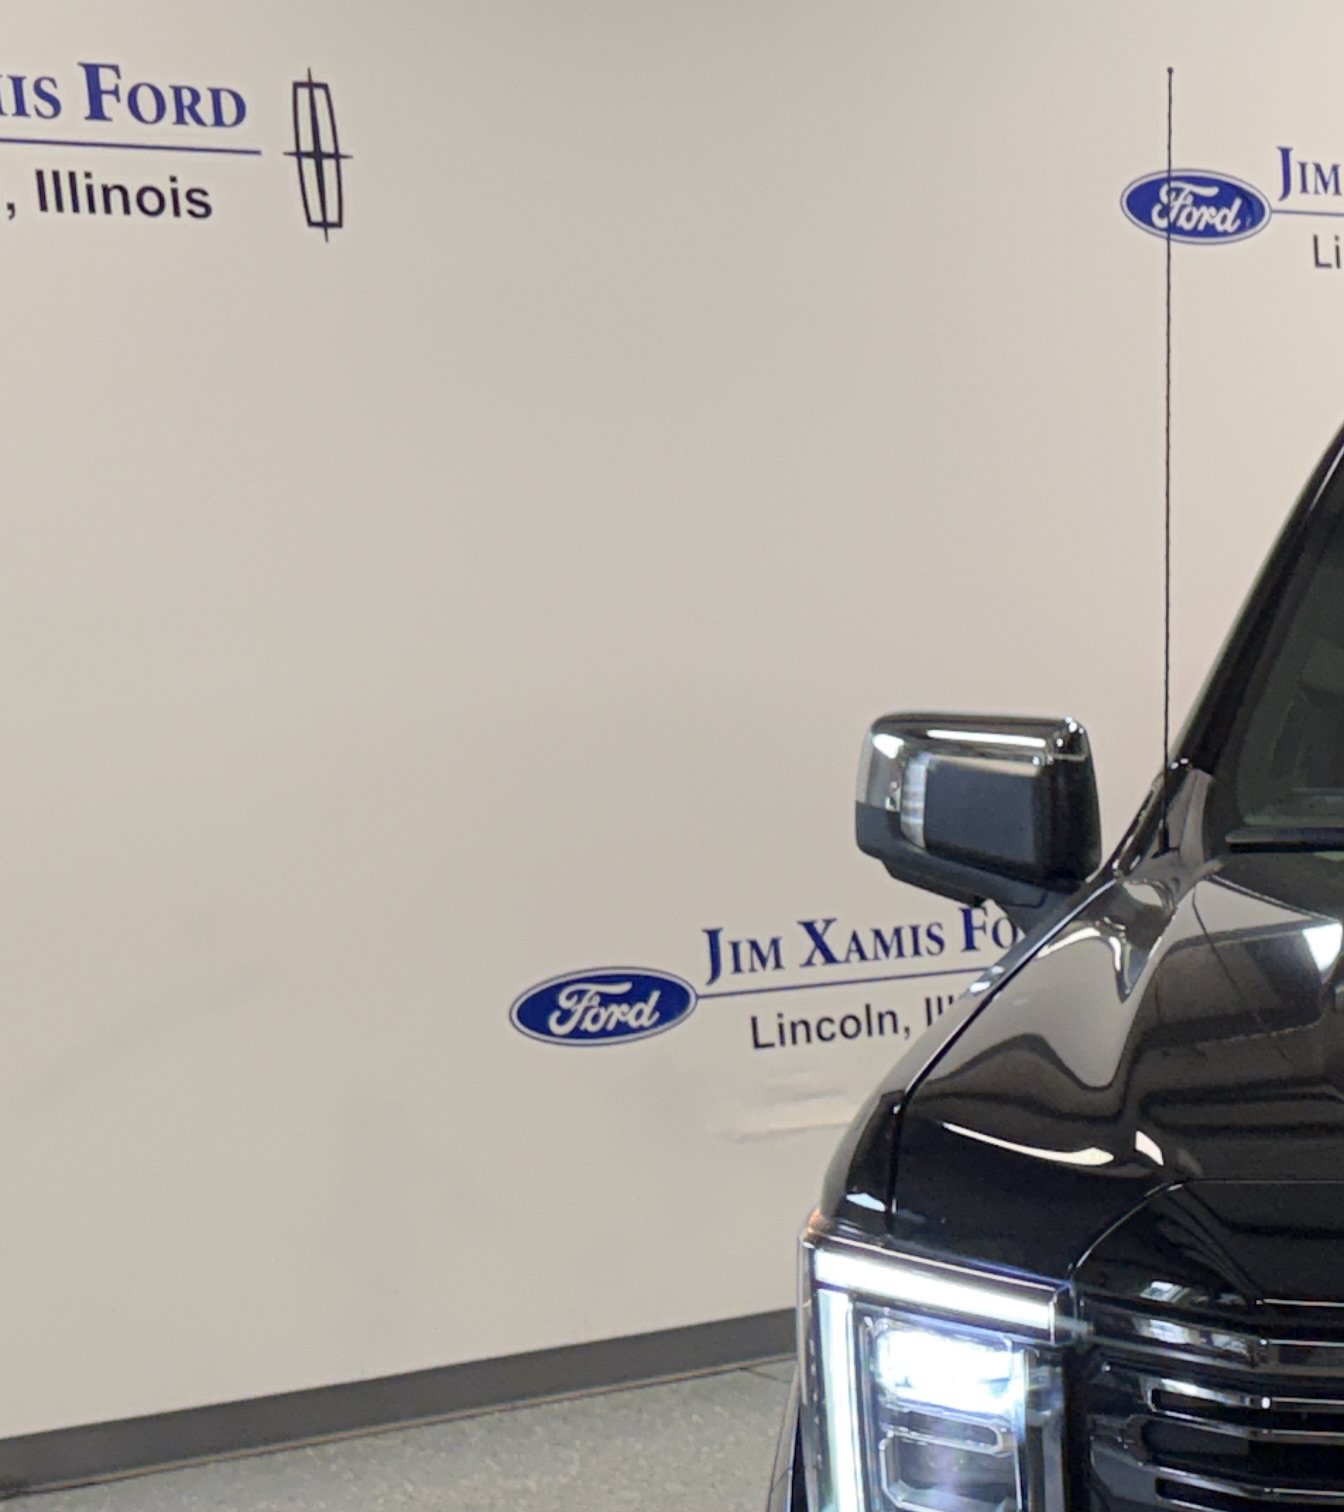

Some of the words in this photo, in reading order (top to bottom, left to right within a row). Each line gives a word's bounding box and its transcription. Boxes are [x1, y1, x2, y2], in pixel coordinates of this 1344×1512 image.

[77, 62, 247, 128] FORD
[35, 169, 212, 219] Illinois
[1276, 146, 1342, 201] JIM
[1152, 181, 1242, 233] Ford
[702, 928, 785, 986] JIM
[797, 917, 946, 967] XAMIS
[958, 905, 1019, 952] FO
[547, 981, 661, 1034] Ford
[750, 1002, 910, 1050] Lincoln,
